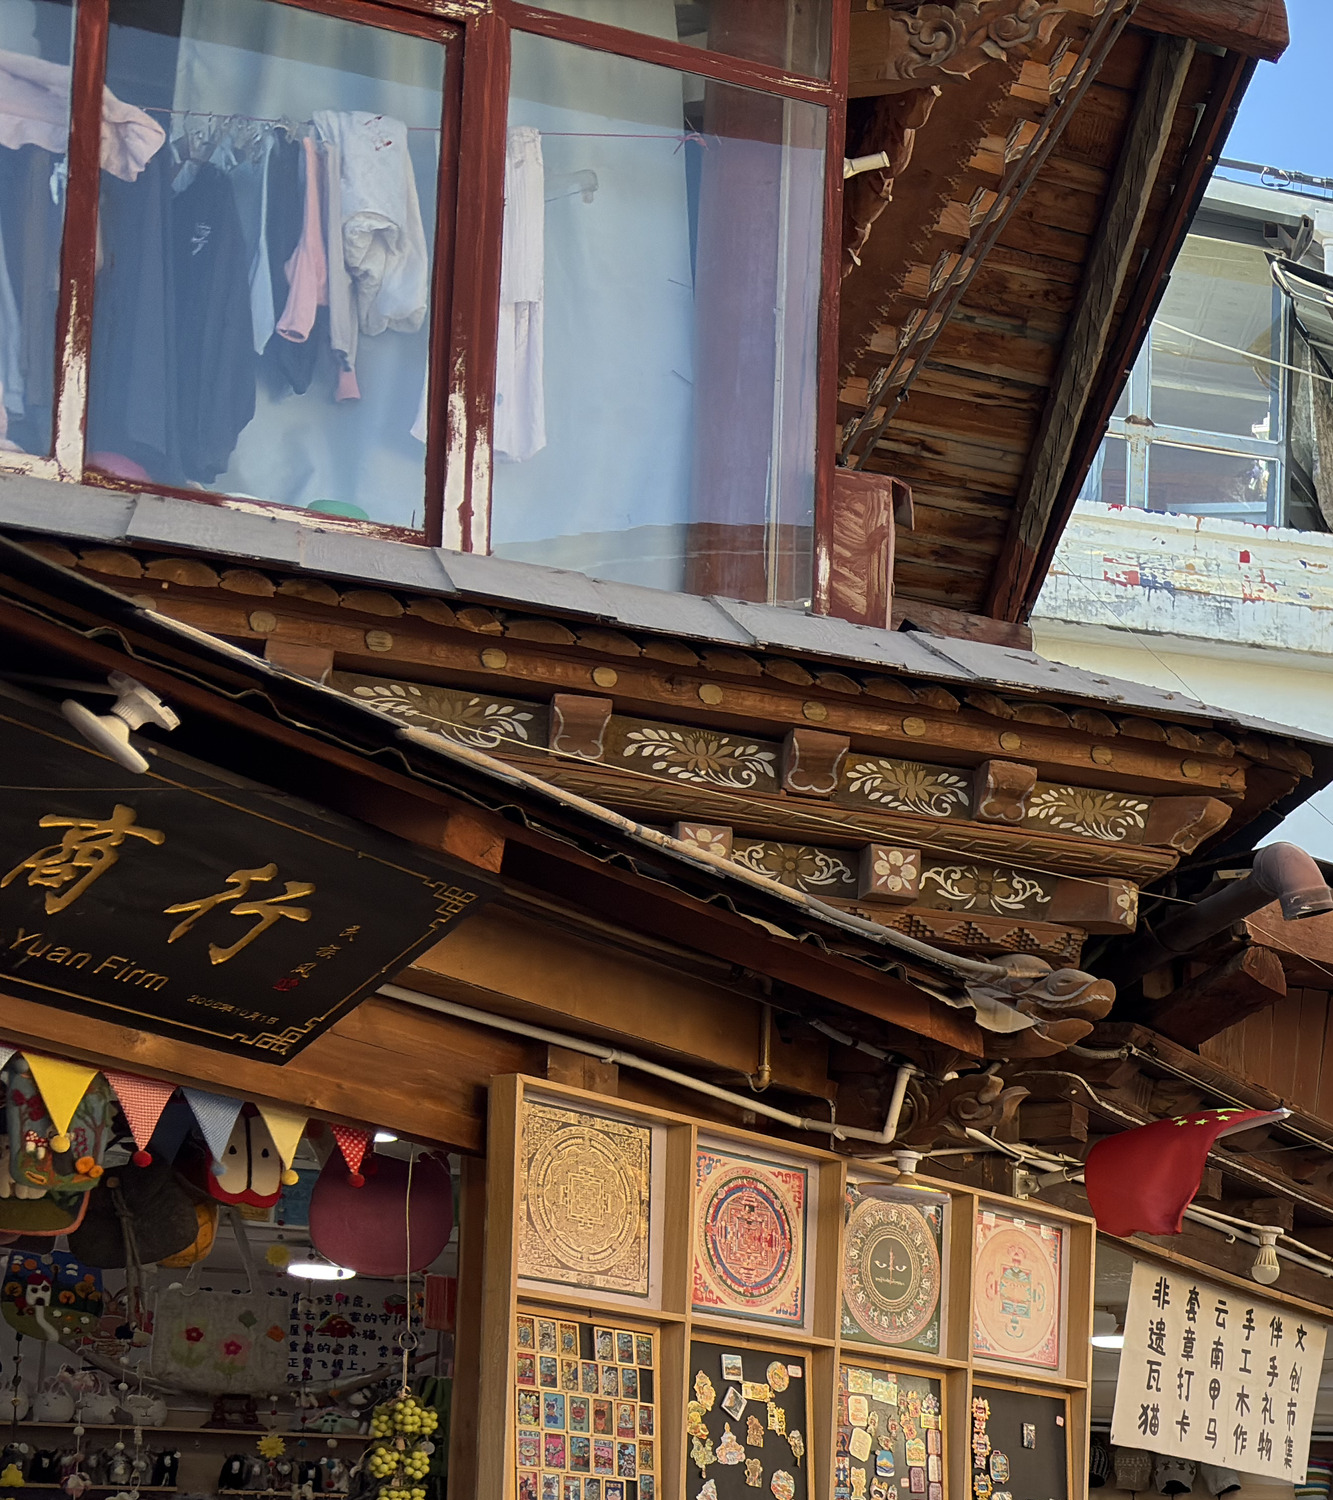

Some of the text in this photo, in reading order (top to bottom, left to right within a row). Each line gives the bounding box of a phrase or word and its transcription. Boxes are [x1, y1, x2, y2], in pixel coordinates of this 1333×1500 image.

[0, 803, 317, 966] 商行
[8, 927, 170, 992] Yuan Firm
[1137, 1276, 1171, 1437] 非遗瓦猫
[1175, 1285, 1201, 1442] 套章打卡
[1204, 1299, 1230, 1449] 云南甲马
[1232, 1308, 1256, 1456] 手工木作
[1256, 1315, 1283, 1462] 伴手礼物
